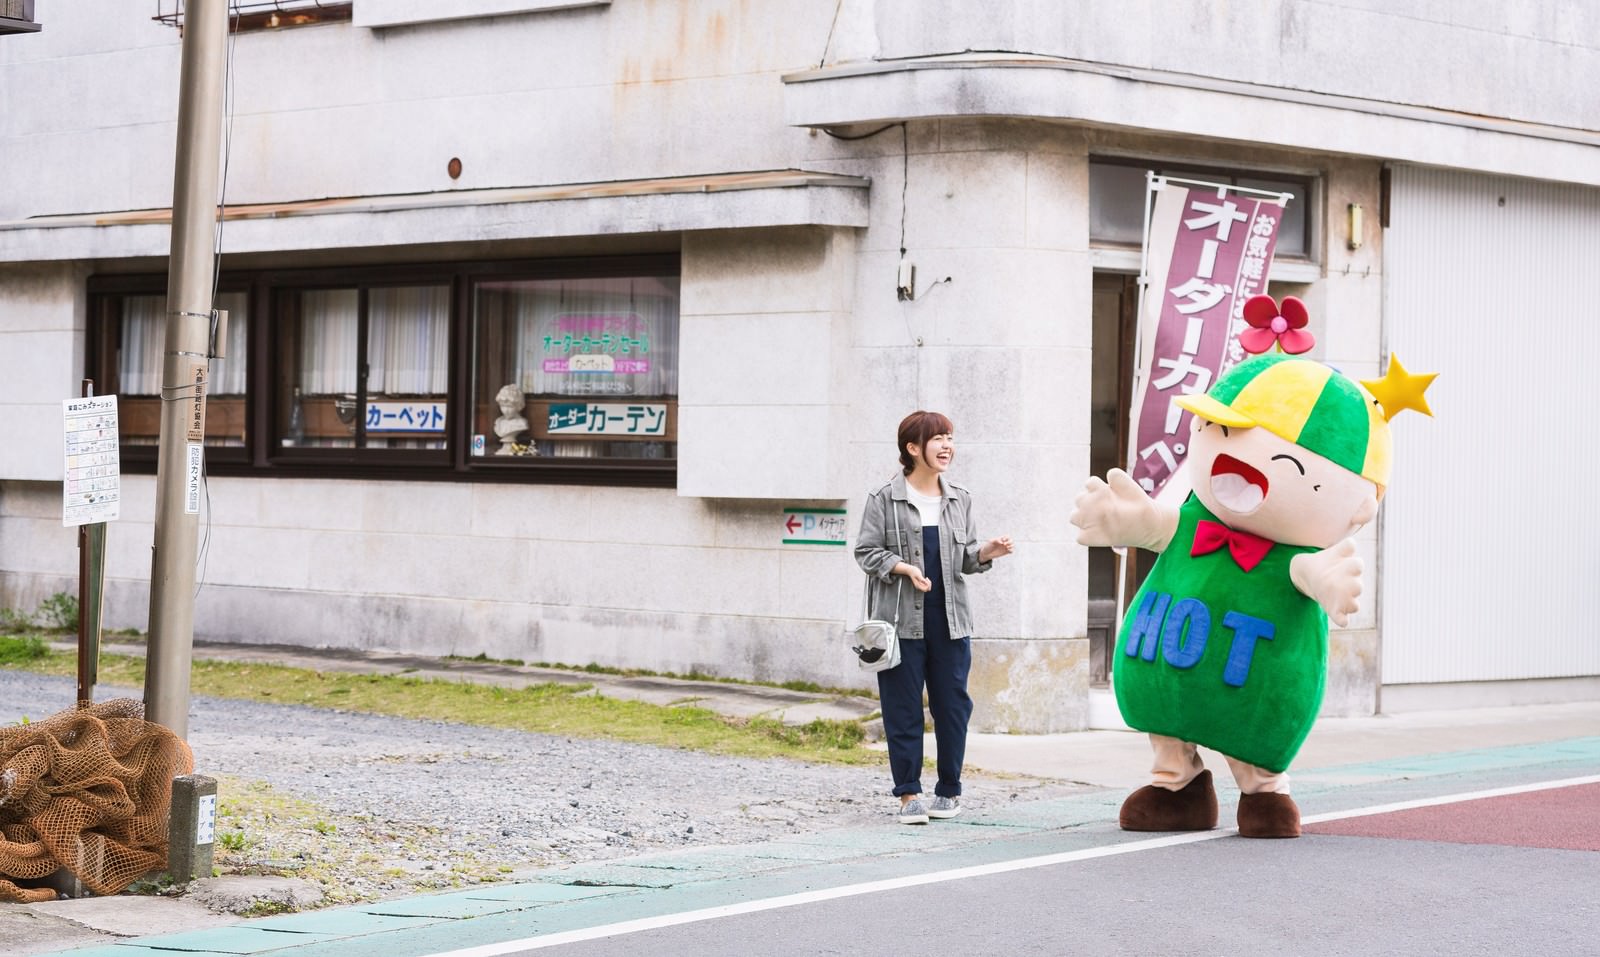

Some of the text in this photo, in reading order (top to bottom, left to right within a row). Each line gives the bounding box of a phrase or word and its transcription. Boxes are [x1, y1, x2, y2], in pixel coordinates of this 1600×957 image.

[1139, 186, 1248, 491] オーダーカーペ
[367, 404, 443, 428] カーペット
[1126, 591, 1276, 688] HOT
